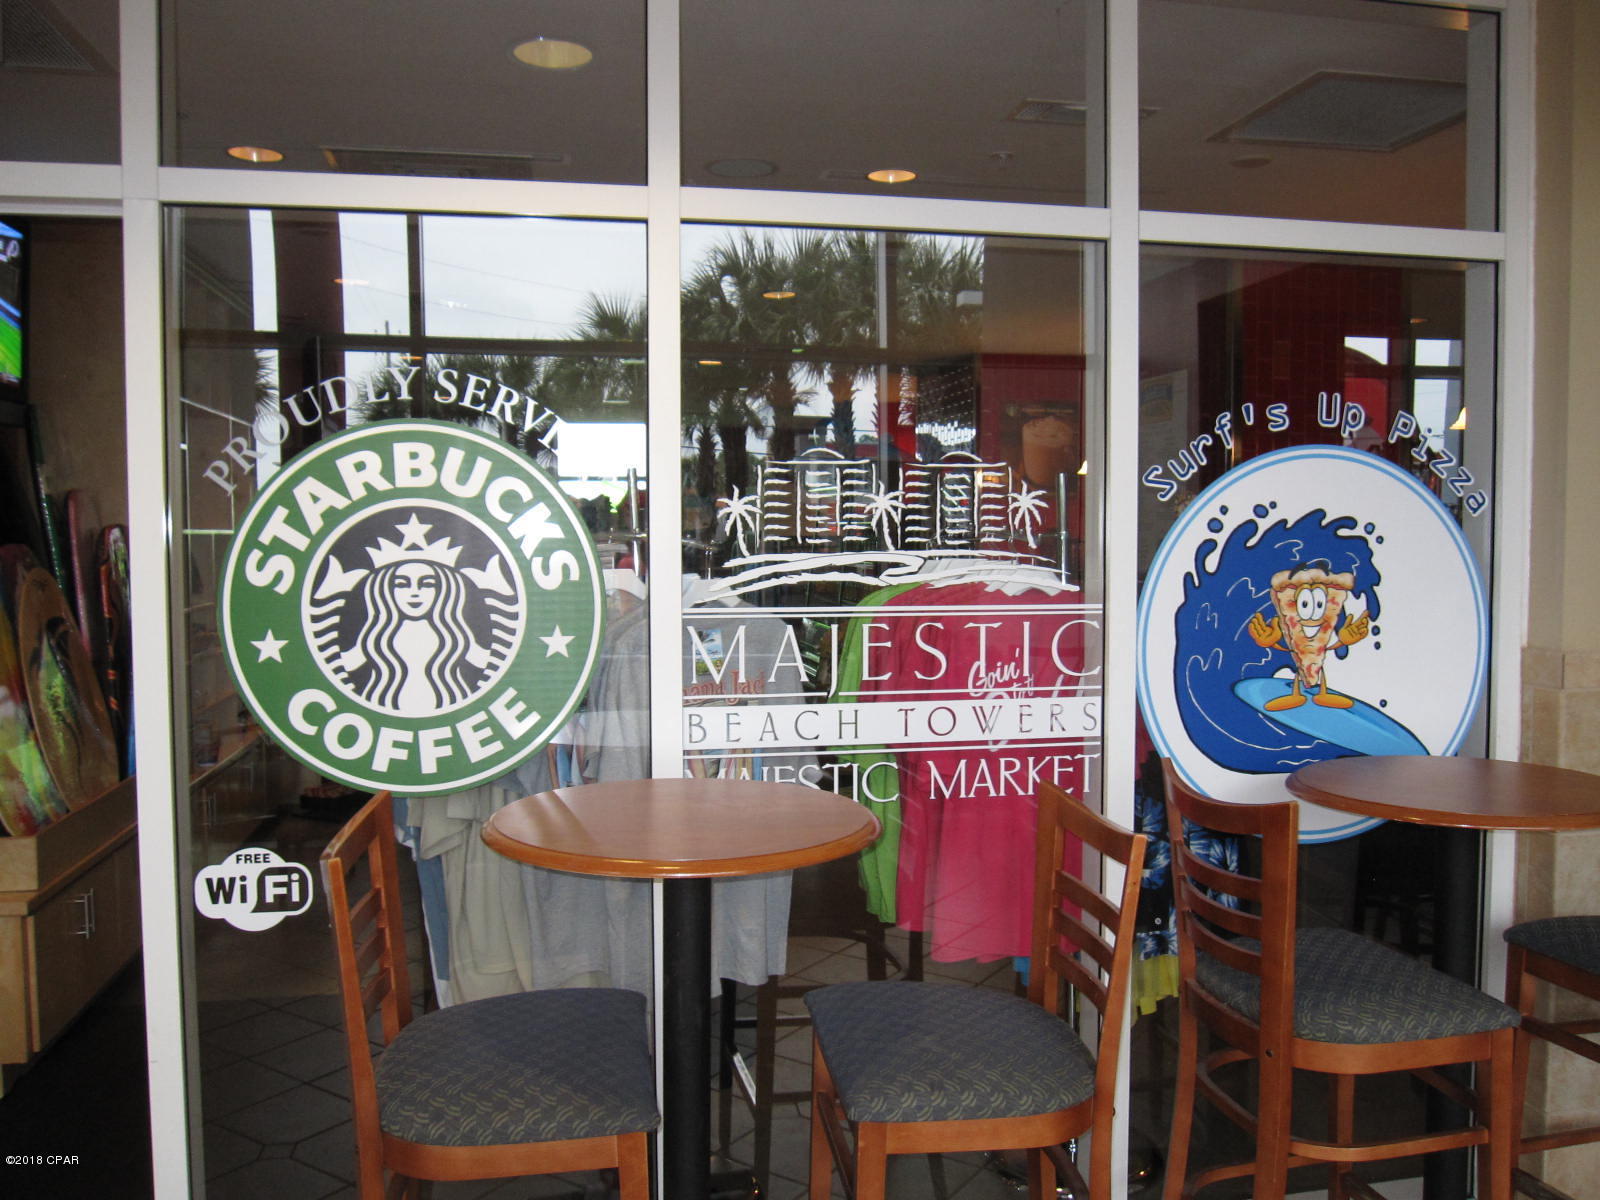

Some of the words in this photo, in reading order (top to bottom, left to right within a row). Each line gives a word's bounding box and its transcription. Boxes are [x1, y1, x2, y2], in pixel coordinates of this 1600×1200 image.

[203, 366, 421, 496] PROUDLY
[433, 368, 567, 457] SERVI
[1143, 403, 1290, 501] Surf's
[1317, 392, 1365, 437] Up
[1388, 410, 1487, 517] Pizza
[244, 441, 580, 595] STARBUCKS
[686, 619, 1102, 698] MAJESTIC
[287, 686, 542, 774] COFFEE
[688, 707, 860, 744] BEACH
[897, 701, 1098, 738] TOWERS
[926, 753, 1101, 801] MARKET
[235, 853, 271, 864] FREE
